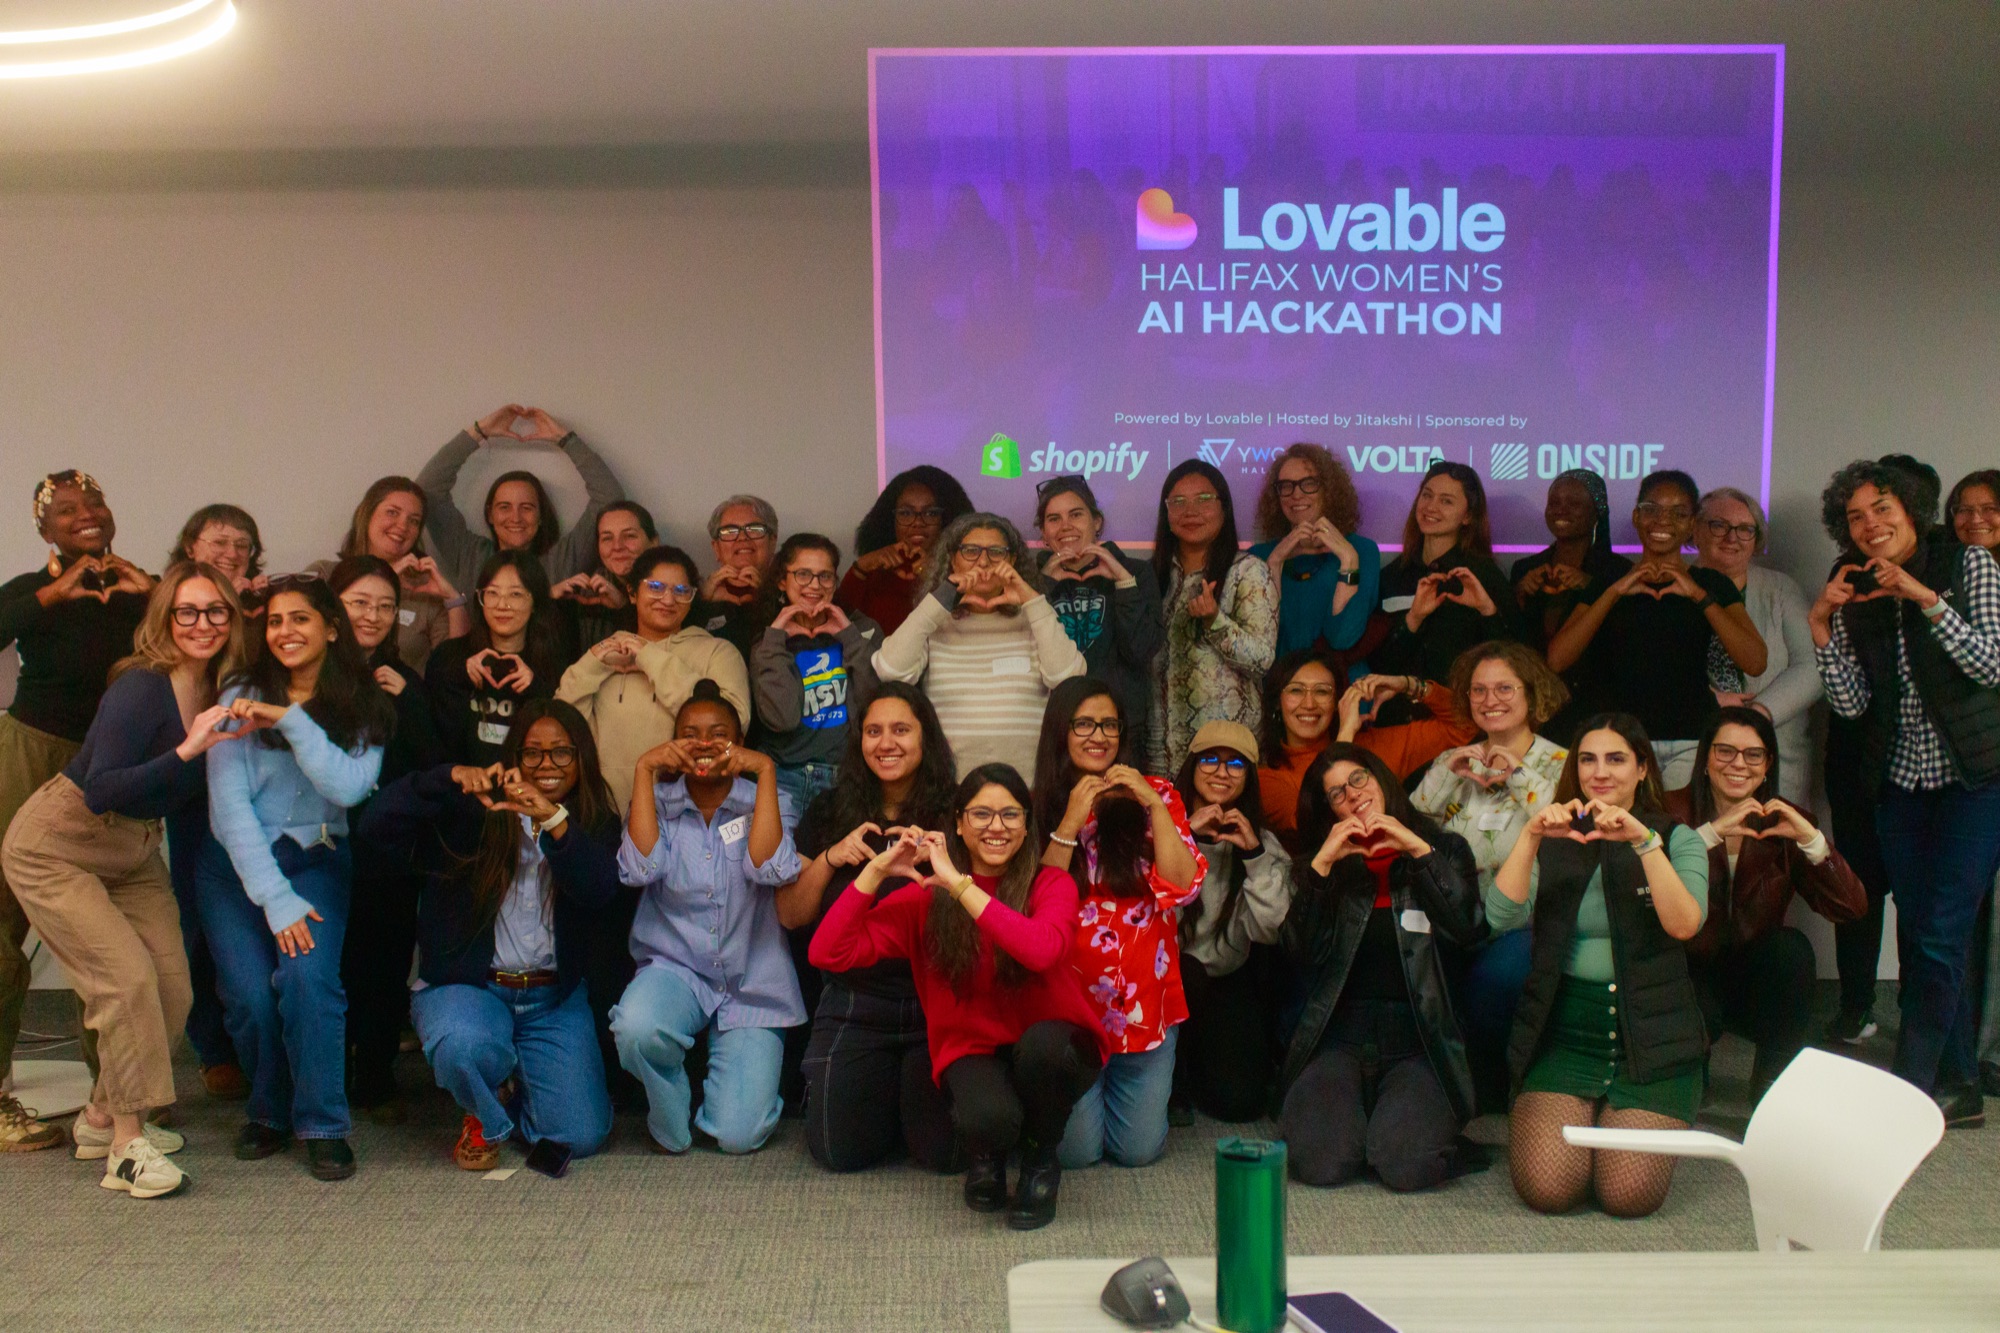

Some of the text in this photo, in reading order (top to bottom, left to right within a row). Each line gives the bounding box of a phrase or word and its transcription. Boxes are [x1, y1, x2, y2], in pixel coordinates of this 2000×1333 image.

[1223, 187, 1506, 252] Lovable
[1140, 262, 1503, 293] HALIFAX WOMEN'S
[1137, 301, 1502, 335] AI HACKATHON
[1113, 411, 1180, 425] Powered
[1184, 411, 1203, 428] by
[1206, 411, 1264, 425] Lovable
[1276, 412, 1330, 426] Hosted
[1333, 412, 1352, 429] by
[1355, 413, 1413, 427] Jitakshi
[1425, 414, 1506, 430] Sponsored
[1509, 414, 1529, 430] by
[1028, 442, 1150, 481] shopify
[1346, 445, 1446, 473] VOLTA
